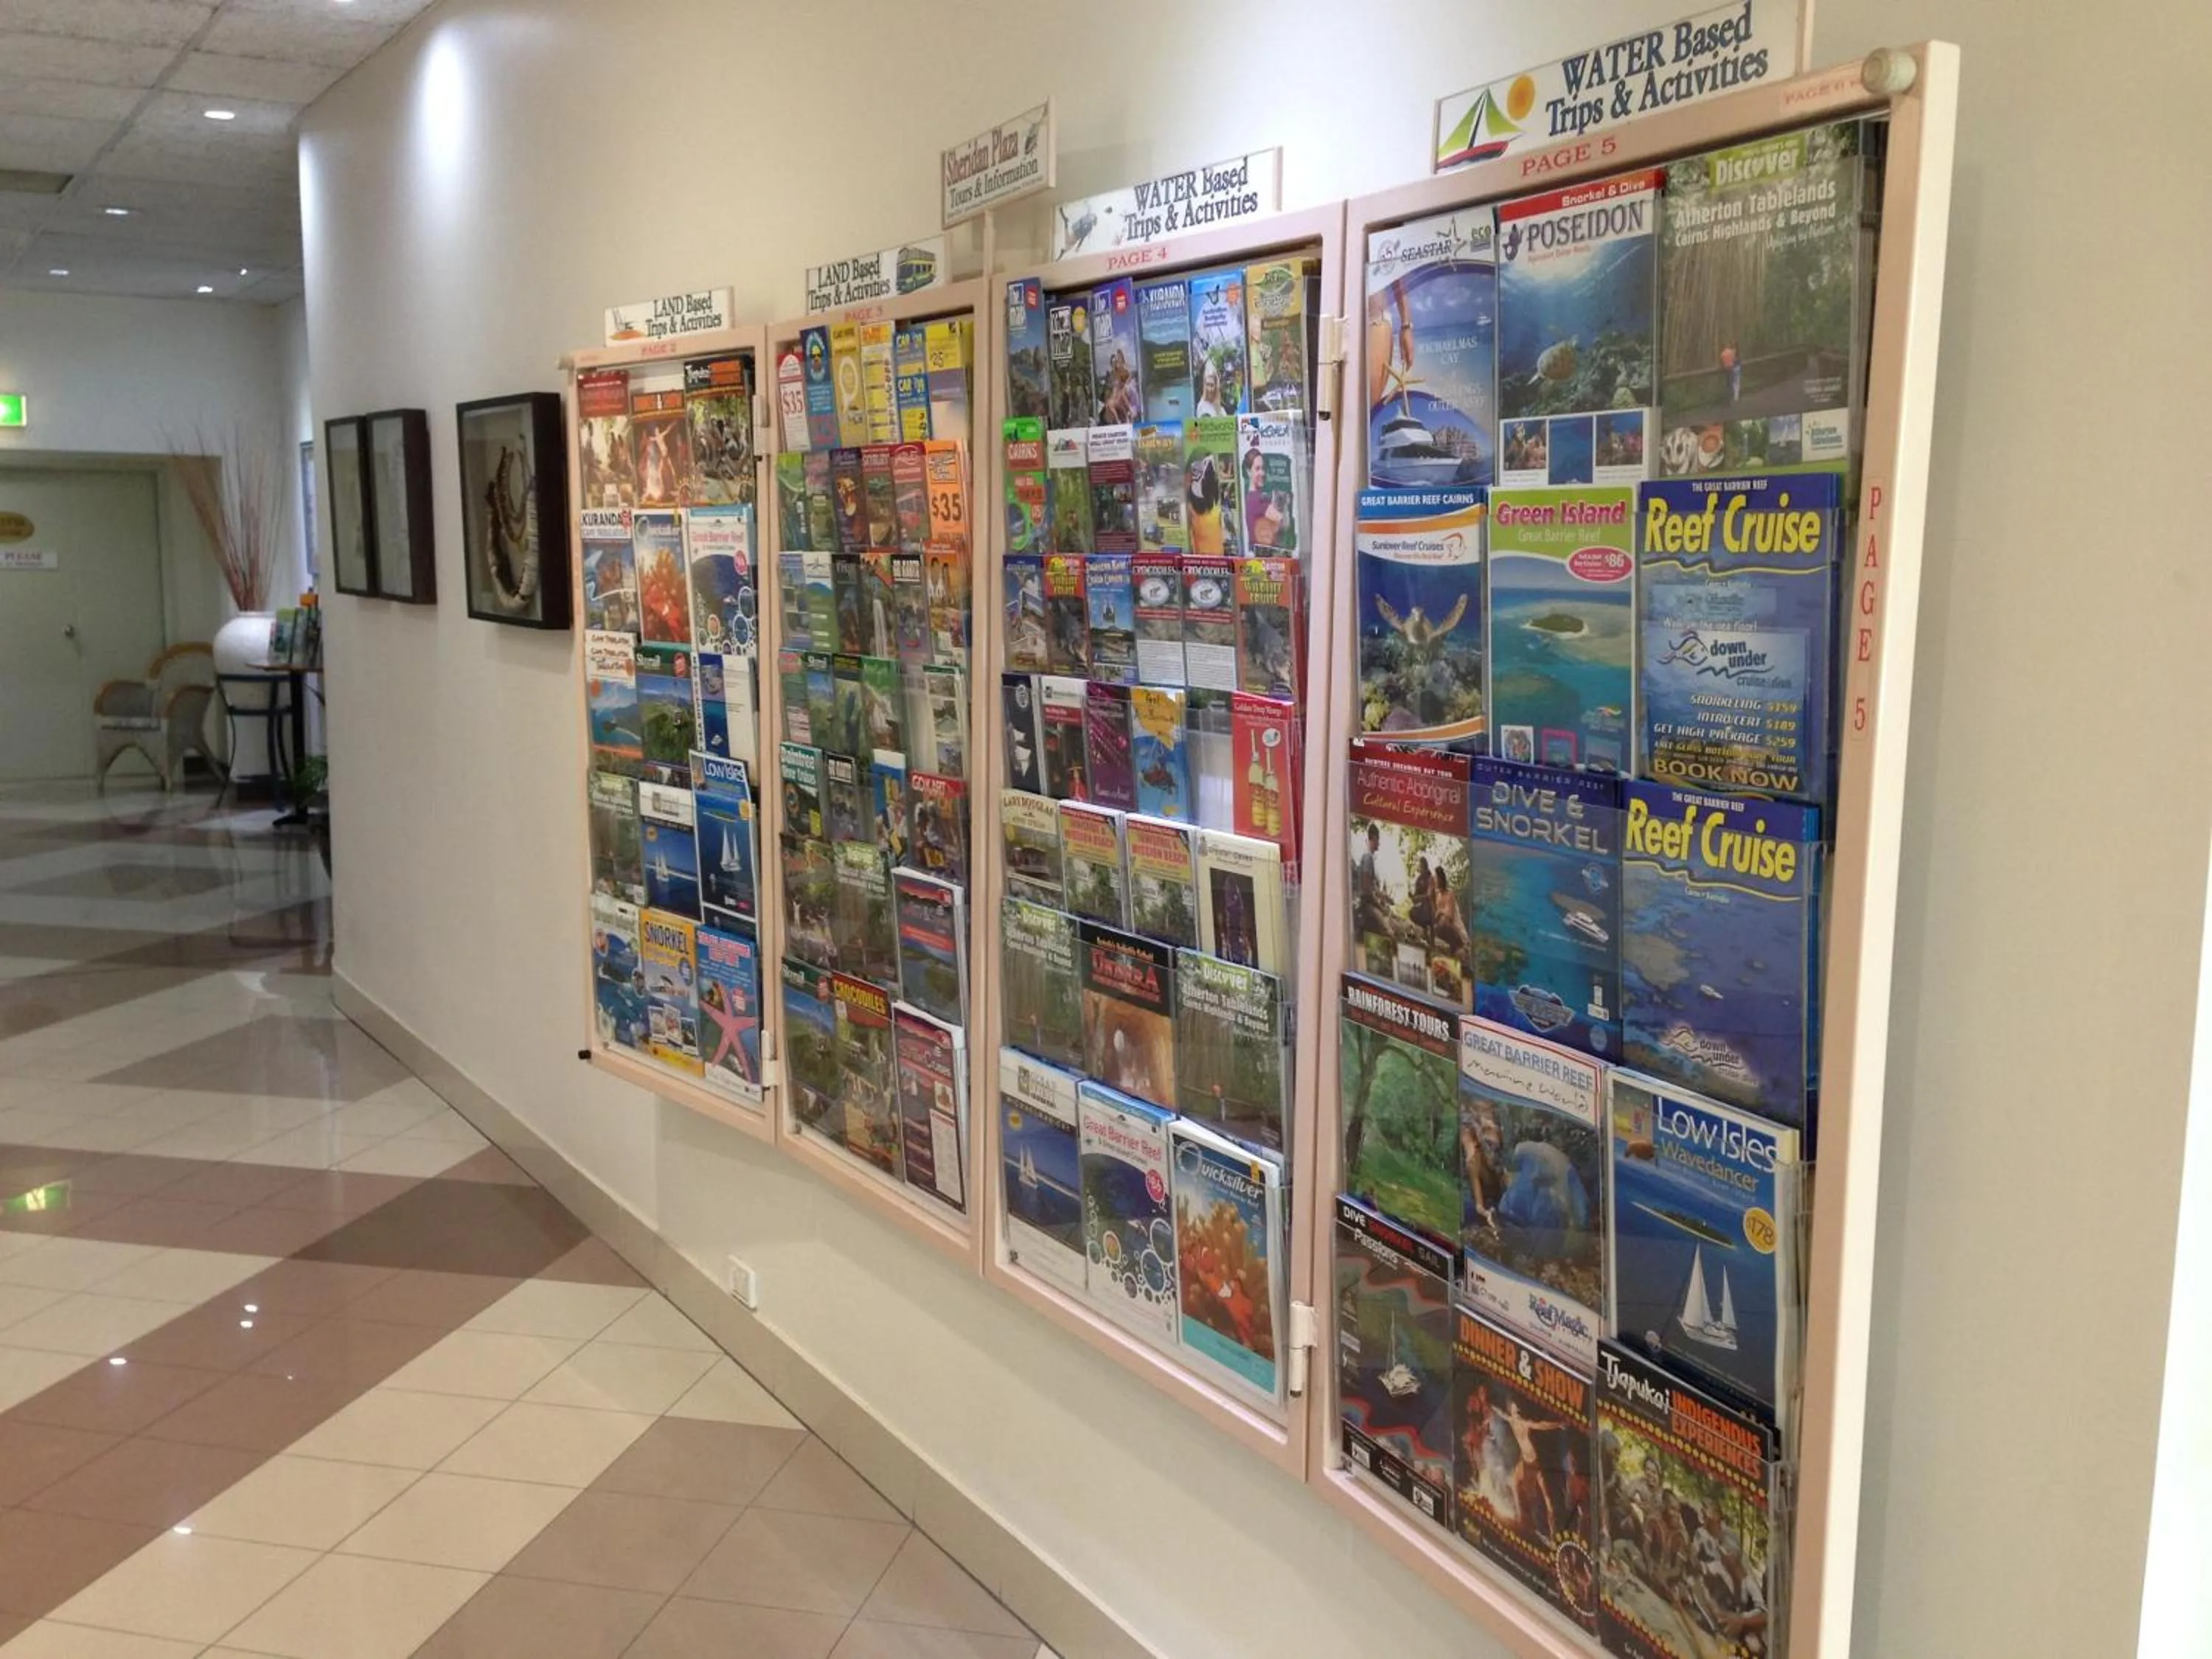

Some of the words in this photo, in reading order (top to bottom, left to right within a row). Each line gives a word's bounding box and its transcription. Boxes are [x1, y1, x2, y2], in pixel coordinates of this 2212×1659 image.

[1562, 31, 1666, 96] WATER
[1672, 1, 1752, 63] Based
[1546, 93, 1604, 136] Trips
[1610, 78, 1632, 119] &
[1639, 46, 1768, 111] Activities
[945, 142, 990, 185] Sheridan
[992, 128, 1019, 167] Plaza
[1521, 143, 1590, 178] PAGE
[1601, 137, 1617, 155] 5
[1716, 147, 1801, 186] Discover
[949, 187, 973, 210] Tours
[974, 179, 983, 195] &
[984, 156, 1039, 194] Information
[1133, 173, 1199, 212] WATER
[1202, 156, 1249, 195] Based
[1562, 187, 1604, 209] Snorkel
[1608, 184, 1617, 197] &
[1620, 181, 1646, 193] Dive
[1126, 212, 1161, 243] Trips
[1164, 207, 1179, 232] &
[1183, 189, 1258, 229] Activities
[1675, 200, 1742, 229] Atherton
[1748, 180, 1837, 214] Tablelands
[1527, 201, 1646, 251] POSEIDON
[1675, 229, 1709, 247] Cairns
[1712, 219, 1772, 240] Highlands
[1775, 212, 1785, 228] &
[1790, 203, 1836, 225] Beyond
[1107, 250, 1152, 271] PAGE
[1157, 248, 1168, 261] 4
[1400, 240, 1452, 261] SEASTAR
[818, 266, 851, 289] LAND
[853, 254, 880, 280] Based
[653, 299, 684, 319] LAND
[686, 292, 713, 313] Based
[808, 290, 832, 310] Trips
[834, 287, 843, 304] &
[844, 278, 891, 302] Activities
[645, 319, 668, 339] Trips
[669, 317, 678, 333] &
[681, 310, 722, 331] Activities
[844, 310, 874, 323] PAGE
[641, 344, 667, 355] PAGE
[783, 389, 804, 415] $35
[931, 493, 962, 522] $35
[1361, 495, 1385, 506] GREAT
[1388, 495, 1421, 505] BARRIER
[1422, 494, 1441, 504] REEF
[1443, 493, 1474, 504] CAIRNS
[1497, 501, 1555, 525] Green
[1560, 501, 1627, 524] Island
[1518, 529, 1543, 542] Great
[1545, 529, 1577, 541] Barrier
[1579, 529, 1600, 542] Reef
[1645, 493, 1719, 553] Reef
[1722, 493, 1821, 553] Cruise
[1419, 540, 1444, 551] Cruises
[1710, 640, 1746, 656] down
[1728, 652, 1767, 668] under
[1854, 698, 1866, 731] 5
[1654, 723, 1672, 734] GET
[1677, 726, 1705, 739] HIGH
[1708, 728, 1761, 745] PACKAGE
[1407, 779, 1461, 805] Aboriginal
[1653, 759, 1722, 782] BOOK
[1731, 765, 1798, 791] NOW
[1491, 780, 1557, 814] DIVE
[1567, 794, 1585, 820] &
[1475, 807, 1609, 855] SNORKEL
[1625, 798, 1697, 861] Reef
[1700, 812, 1797, 883] Cruise
[645, 921, 689, 955] SNORKEL
[1347, 986, 1413, 1026] RAINFOREST
[1412, 1009, 1450, 1043] TOURS
[1463, 1032, 1502, 1056] GREAT
[1504, 1044, 1562, 1079] BARRIER
[1562, 1062, 1594, 1091] REEF
[1700, 1039, 1727, 1052] down
[1713, 1051, 1740, 1064] under
[1084, 1115, 1107, 1136] Great
[1108, 1124, 1140, 1151] Barrier
[1141, 1139, 1162, 1161] Reef
[1658, 1096, 1718, 1150] Low
[1721, 1119, 1778, 1174] Isles
[1178, 1140, 1264, 1200] Quicksilver
[1660, 1138, 1759, 1192] Wavedancer
[1343, 1206, 1366, 1226] DIVE
[1461, 1314, 1517, 1372] DINNER
[1518, 1350, 1532, 1380] &
[1534, 1359, 1584, 1411] SHOW
[1601, 1351, 1670, 1414] Tjapukai
[1672, 1389, 1761, 1458] INDIGENOUS
